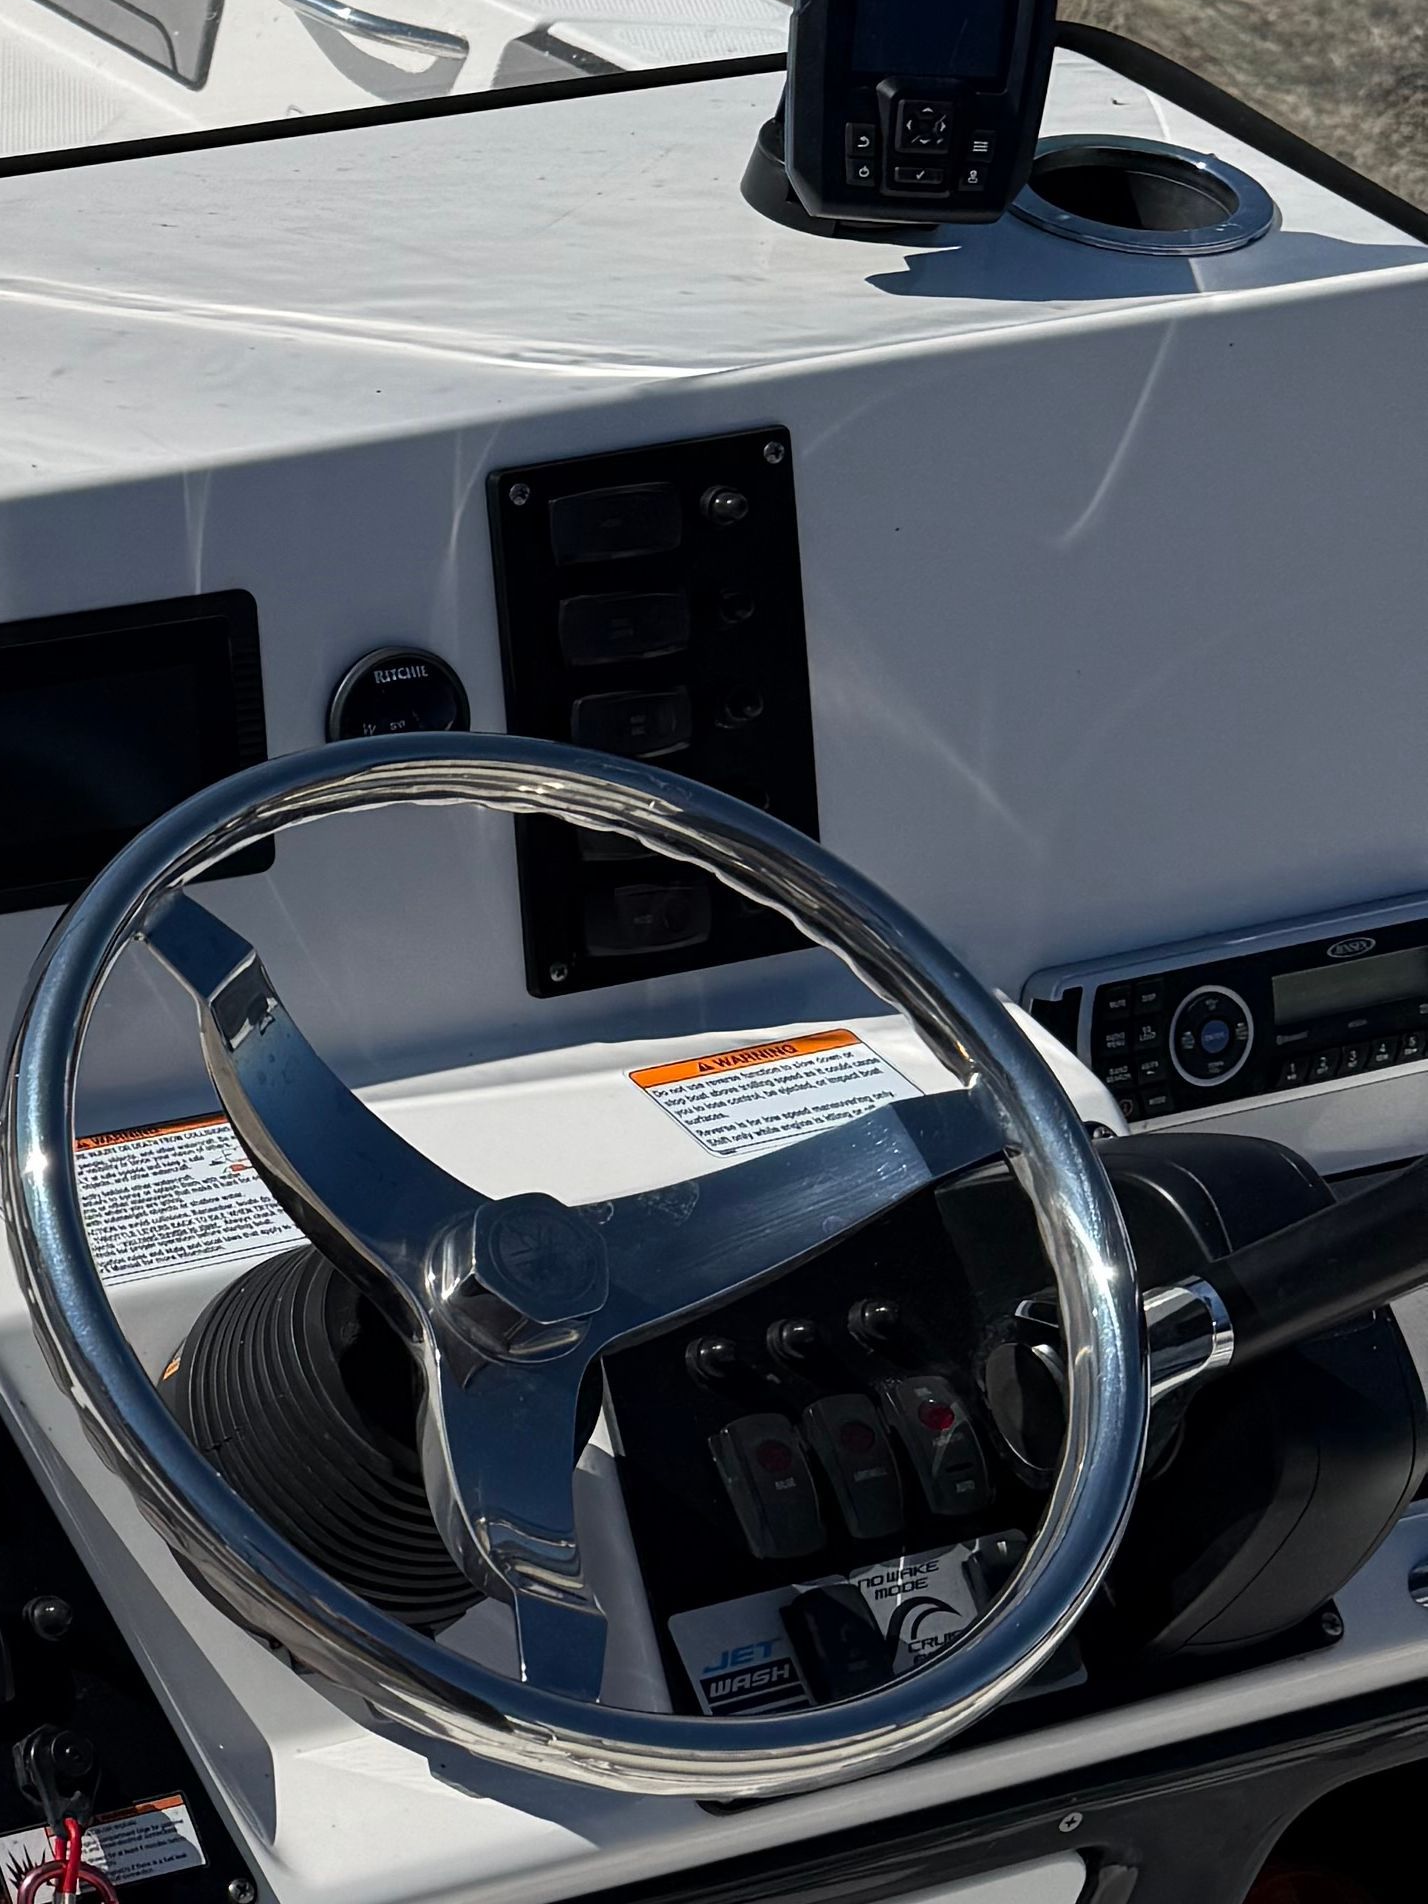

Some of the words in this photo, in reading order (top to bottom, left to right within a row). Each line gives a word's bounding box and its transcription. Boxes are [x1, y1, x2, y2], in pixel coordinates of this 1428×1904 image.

[373, 665, 429, 684] RITCHIE
[712, 1044, 797, 1067] WARNING
[886, 1560, 940, 1583] WAKE
[874, 1576, 929, 1601] MODE
[702, 1637, 782, 1675] JET
[709, 1662, 791, 1698] WASH
